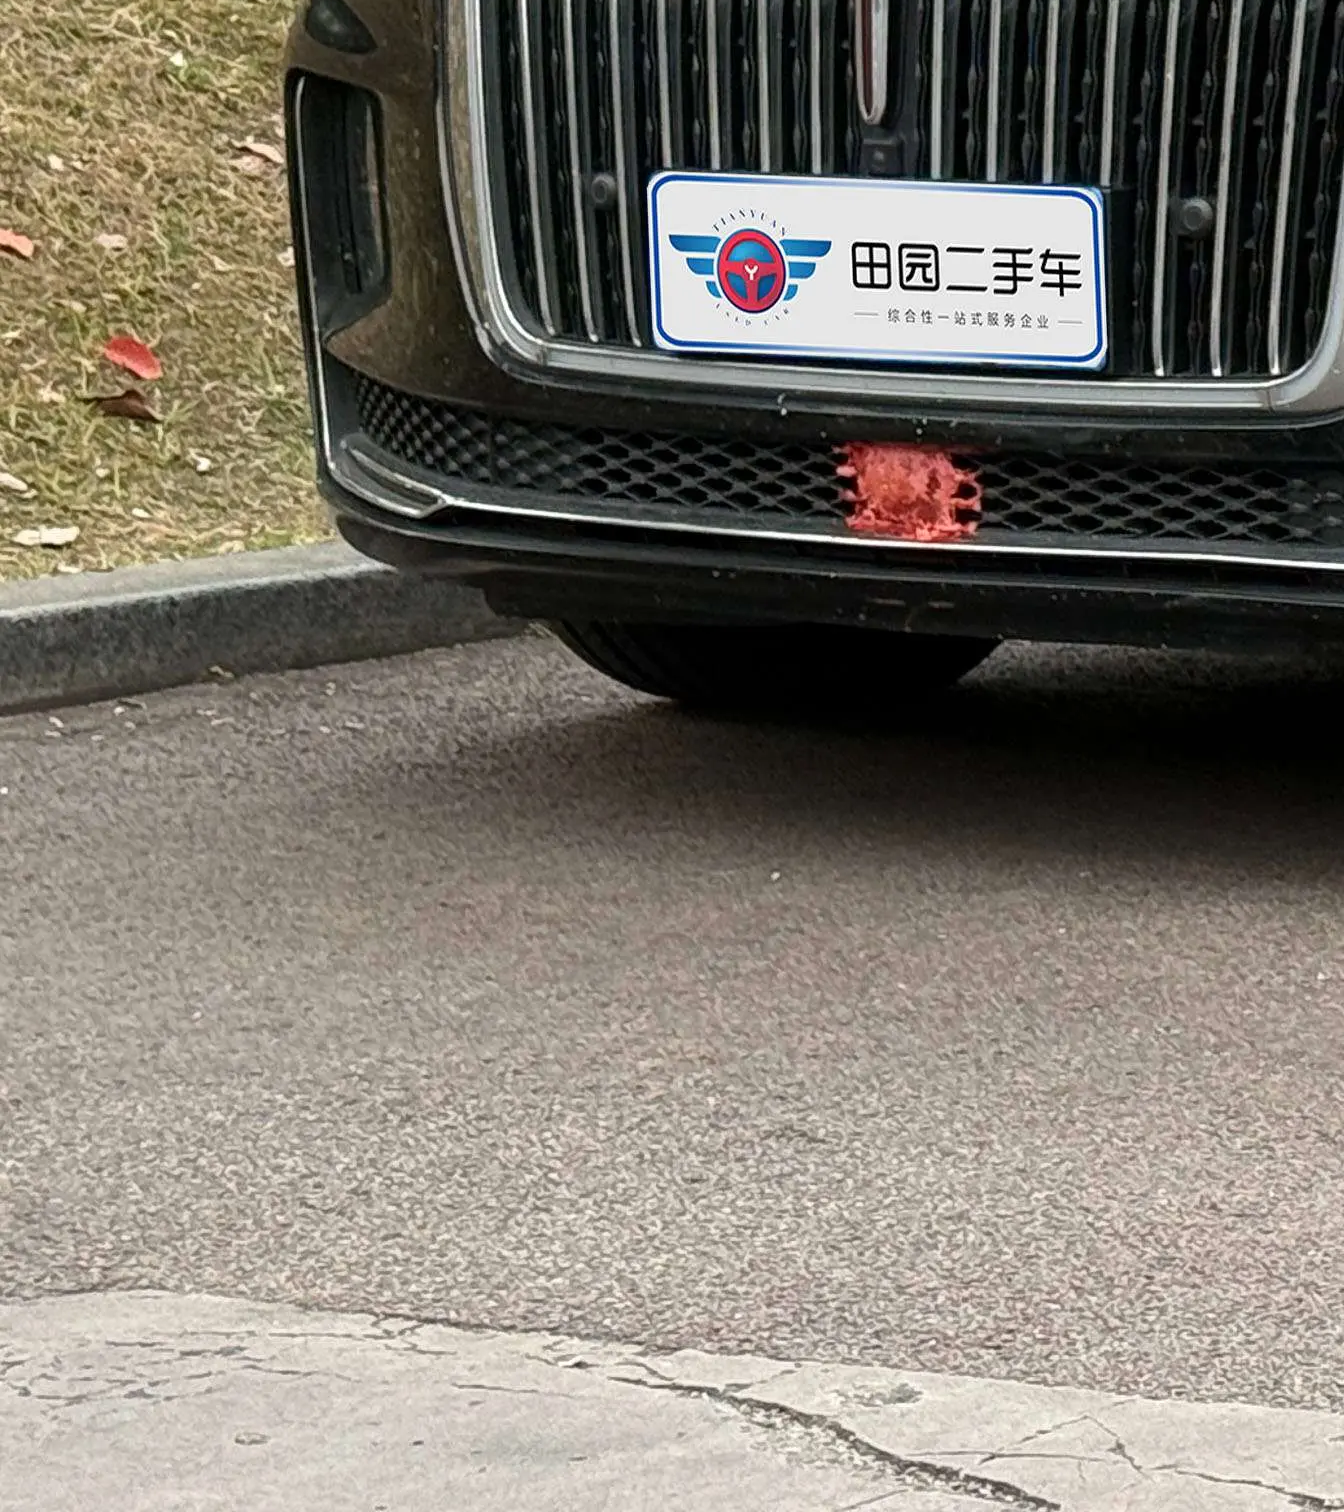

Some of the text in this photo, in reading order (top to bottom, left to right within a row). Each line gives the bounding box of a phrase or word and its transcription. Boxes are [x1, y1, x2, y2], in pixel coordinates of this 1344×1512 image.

[851, 241, 1083, 297] 田园二手车
[887, 307, 1050, 329] 综合性一站式服务企业
